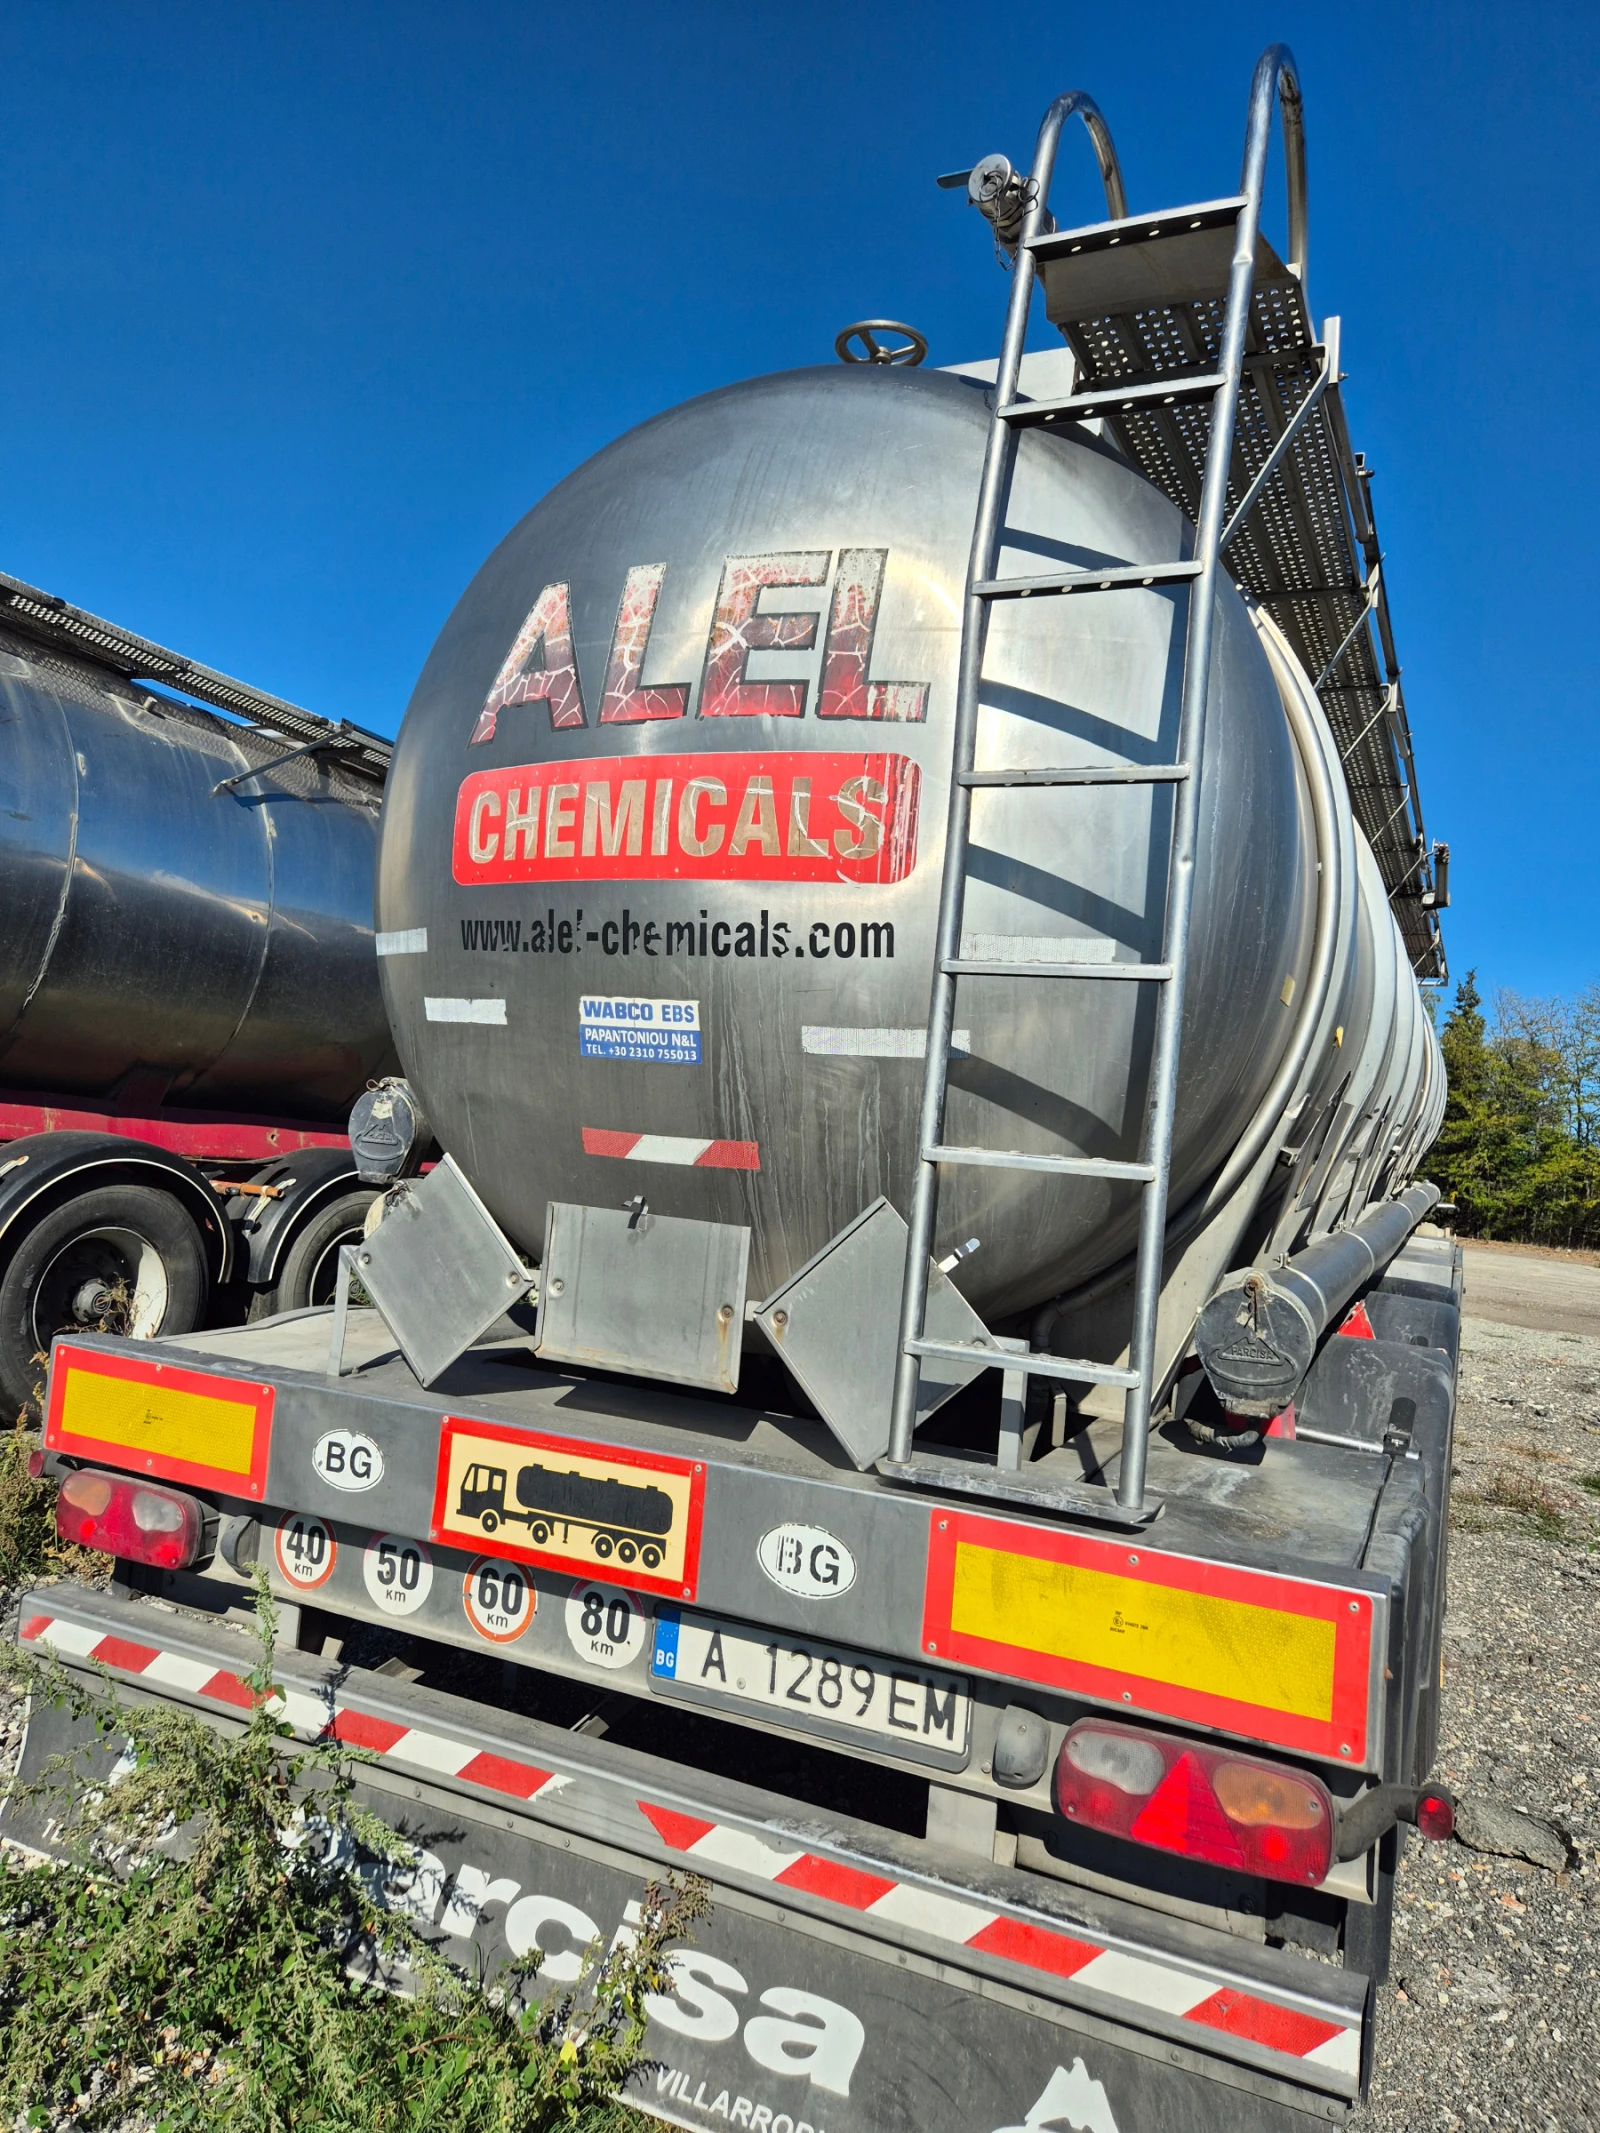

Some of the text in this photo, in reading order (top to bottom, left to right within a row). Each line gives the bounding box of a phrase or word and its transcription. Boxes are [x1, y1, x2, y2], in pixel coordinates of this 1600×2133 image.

[467, 548, 930, 748] ALEL
[469, 776, 887, 864] CHEMICALS
[583, 1001, 694, 1022] WABCO EBS
[585, 1028, 697, 1047] PAPANTONIOU N&L
[586, 1044, 697, 1061] TEL. +30 2310 755013
[1231, 1345, 1274, 1359] PARCISA
[326, 1441, 372, 1479] BG
[286, 1521, 326, 1565] 40
[777, 1535, 841, 1585] BG
[377, 1543, 420, 1591] 50
[478, 1567, 523, 1615] 60
[580, 1591, 630, 1644] 80
[655, 1648, 675, 1668] BG
[656, 2066, 826, 2133] VILLARRO
